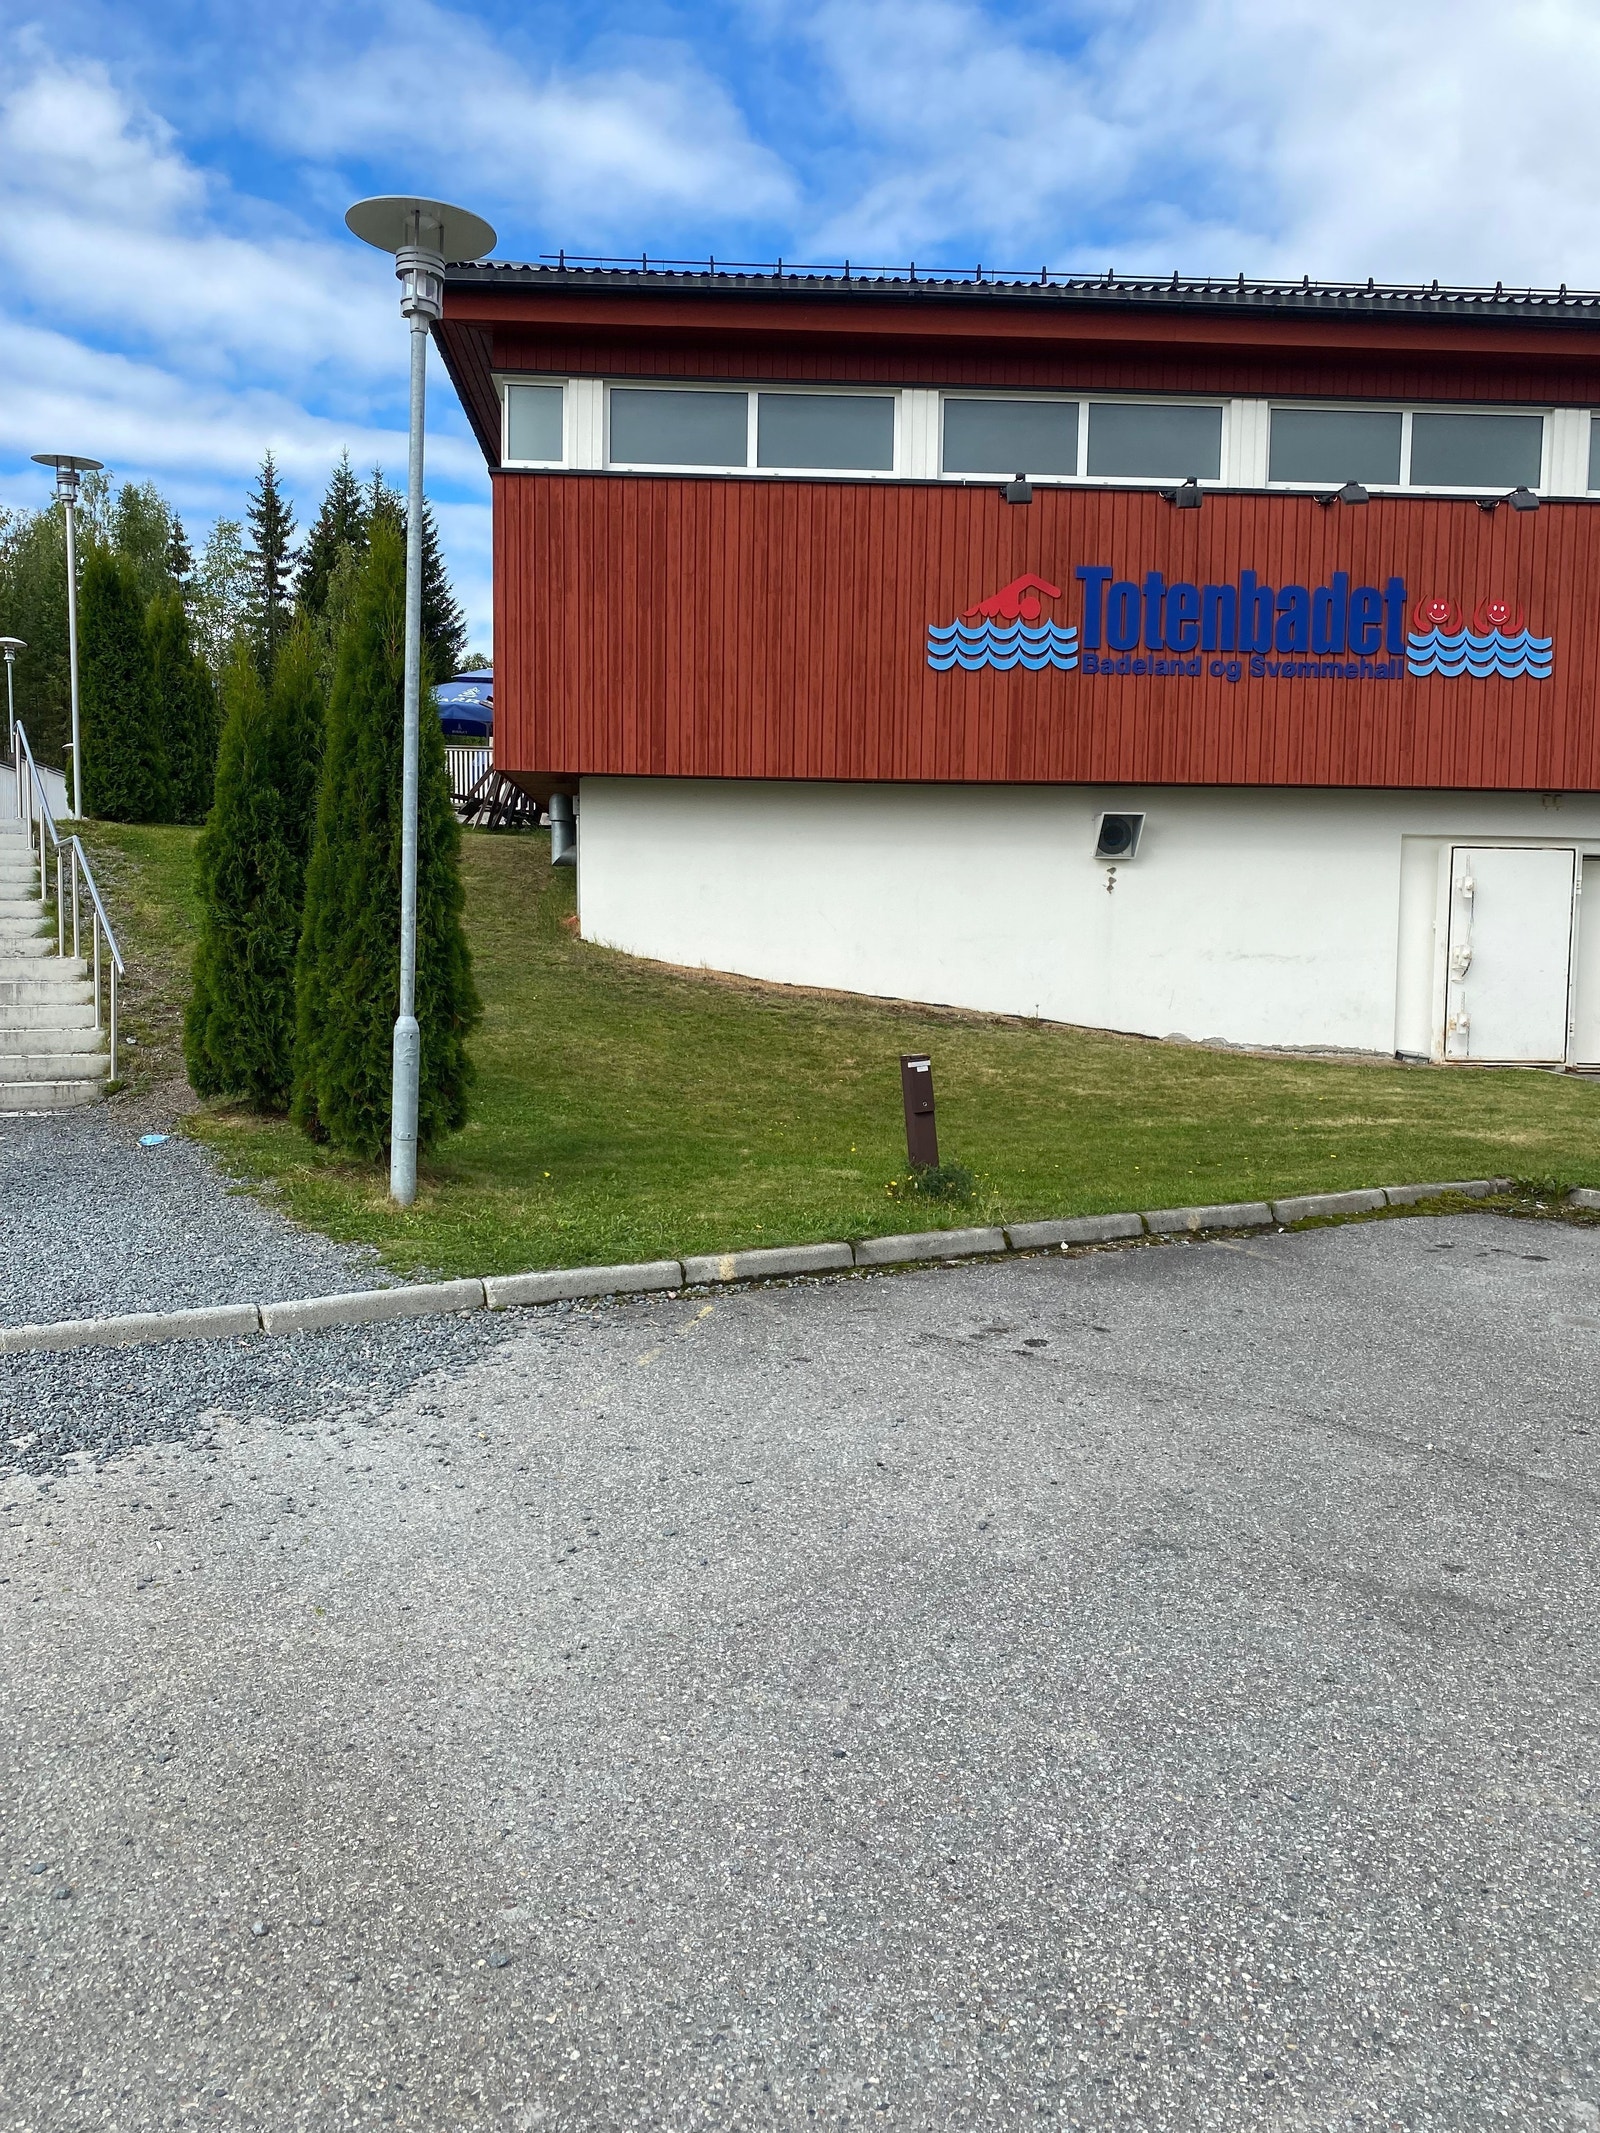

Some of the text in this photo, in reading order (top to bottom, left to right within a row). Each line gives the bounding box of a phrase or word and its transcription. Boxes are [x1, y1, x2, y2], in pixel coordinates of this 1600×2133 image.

[1076, 566, 1407, 655] Totenbadet
[1082, 654, 1404, 682] Badeland og Svømmehall
